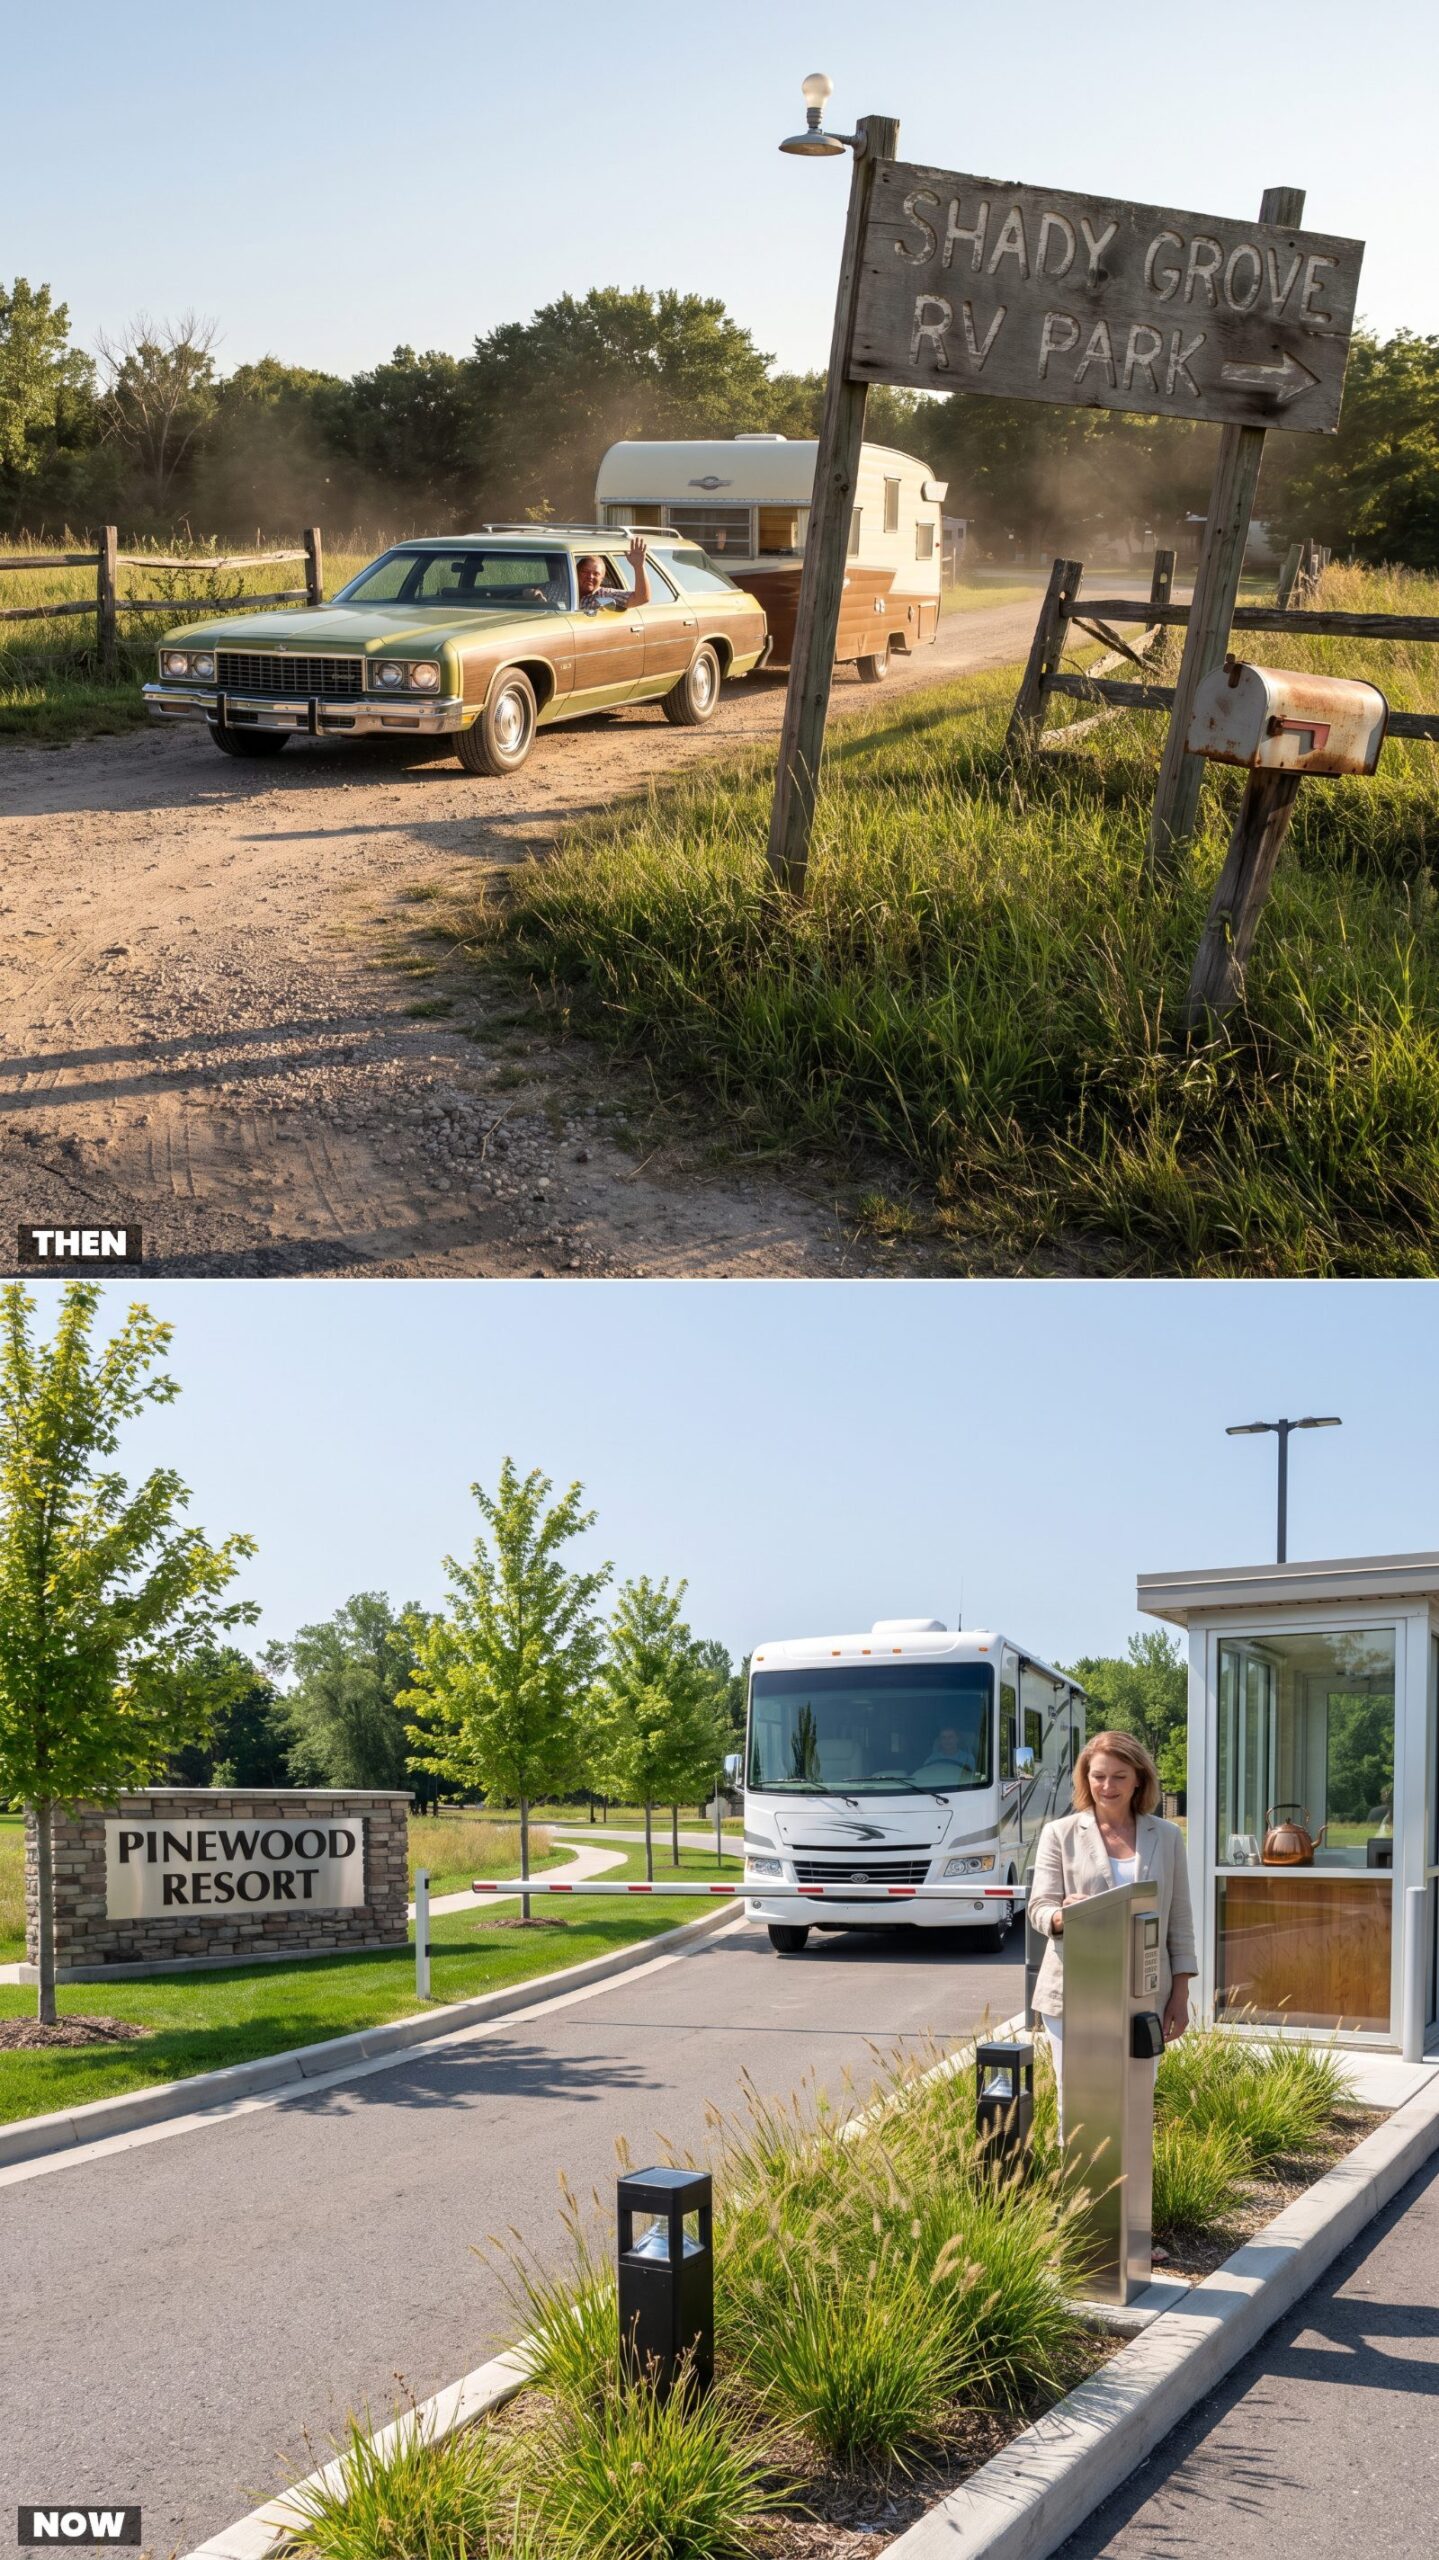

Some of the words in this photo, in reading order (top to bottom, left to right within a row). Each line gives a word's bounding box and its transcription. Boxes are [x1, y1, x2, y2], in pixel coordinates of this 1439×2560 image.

[895, 188, 1120, 289] SHADY
[1144, 230, 1341, 324] GROVE
[909, 294, 1007, 372] RV
[1037, 311, 1206, 399] PARK
[119, 1829, 356, 1864] PINEWOOD
[162, 1869, 319, 1906] RESORT
